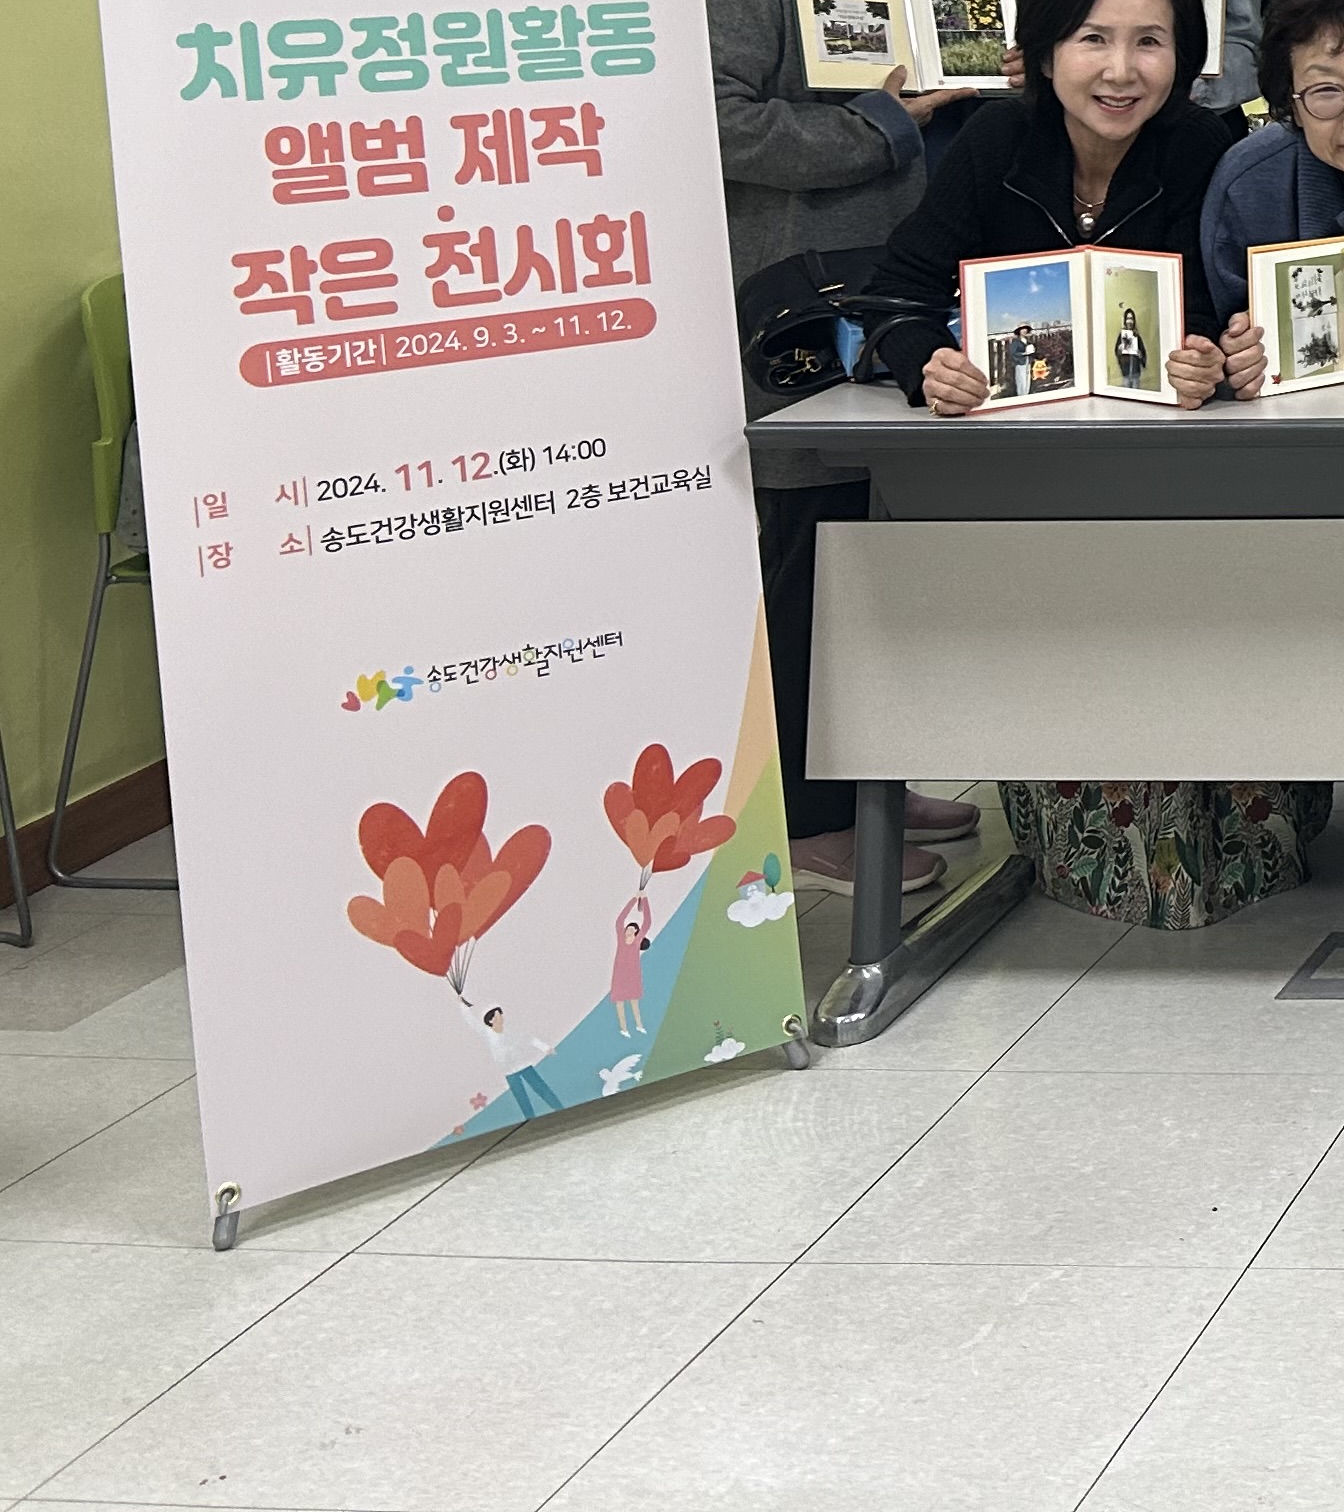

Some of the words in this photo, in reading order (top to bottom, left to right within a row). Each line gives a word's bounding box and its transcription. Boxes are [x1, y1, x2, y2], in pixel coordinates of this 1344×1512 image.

[175, 1, 656, 102] 치유정원활동
[264, 115, 430, 206] 앨범
[449, 101, 606, 186] 제작
[231, 238, 399, 326] 작은
[422, 210, 653, 309] 전시회
[275, 338, 377, 376] 활동기간
[396, 332, 468, 359] 2024.
[473, 327, 497, 348] 9.
[503, 323, 526, 344] 3.
[553, 314, 590, 337] 11.
[596, 309, 632, 332] 12.
[202, 491, 229, 520] 일
[274, 480, 300, 507] 시
[315, 472, 387, 502] 2024.
[394, 460, 444, 492] 11.
[451, 446, 536, 483] 12.(화)
[542, 437, 607, 466] 14:00
[206, 542, 234, 570] 장
[279, 532, 306, 556] 소
[320, 492, 556, 554] 송도건강생활지원센터
[565, 483, 604, 510] 2층
[606, 464, 713, 503] 보건교육실
[426, 630, 624, 693] 송도건강생활지원센터
